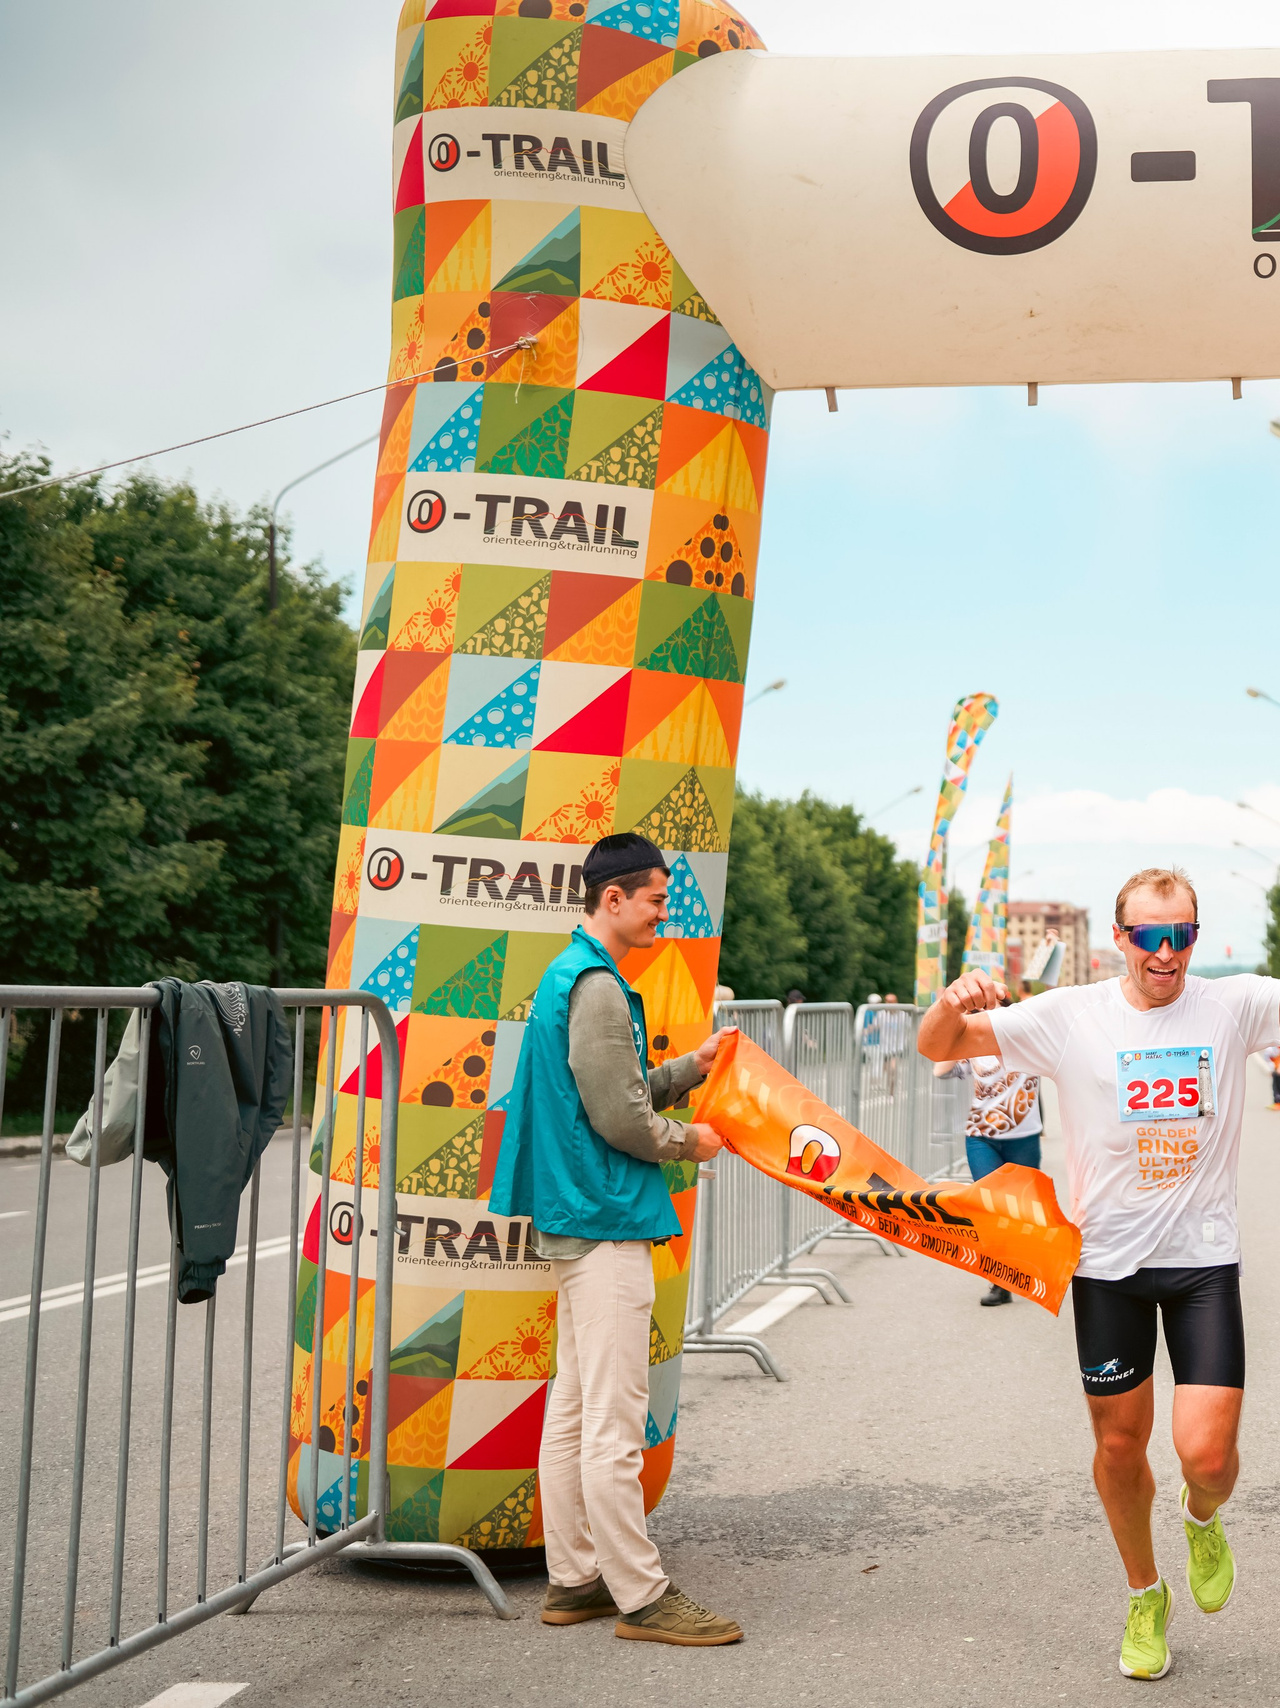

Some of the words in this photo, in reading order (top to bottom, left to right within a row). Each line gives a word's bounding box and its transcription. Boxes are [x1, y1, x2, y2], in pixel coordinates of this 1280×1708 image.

[493, 168, 626, 190] orienteering&trailrunning
[482, 534, 638, 559] orienteering&trailrunning
[439, 894, 586, 915] orienteering&trailrunnin
[1127, 1077, 1200, 1110] 225
[1136, 1125, 1197, 1138] GOLDEN
[1138, 1138, 1199, 1155] RING
[1139, 1154, 1198, 1167] ULTRA
[1139, 1165, 1195, 1180] TRAIL
[1157, 1181, 1176, 1190] 100
[397, 1254, 551, 1273] orienteering&trailrunning
[921, 1233, 959, 1260] СМОТРИ
[979, 1253, 1031, 1292] УДИВЛЯЙСЯ
[1082, 1367, 1135, 1382] KYRUNNER
